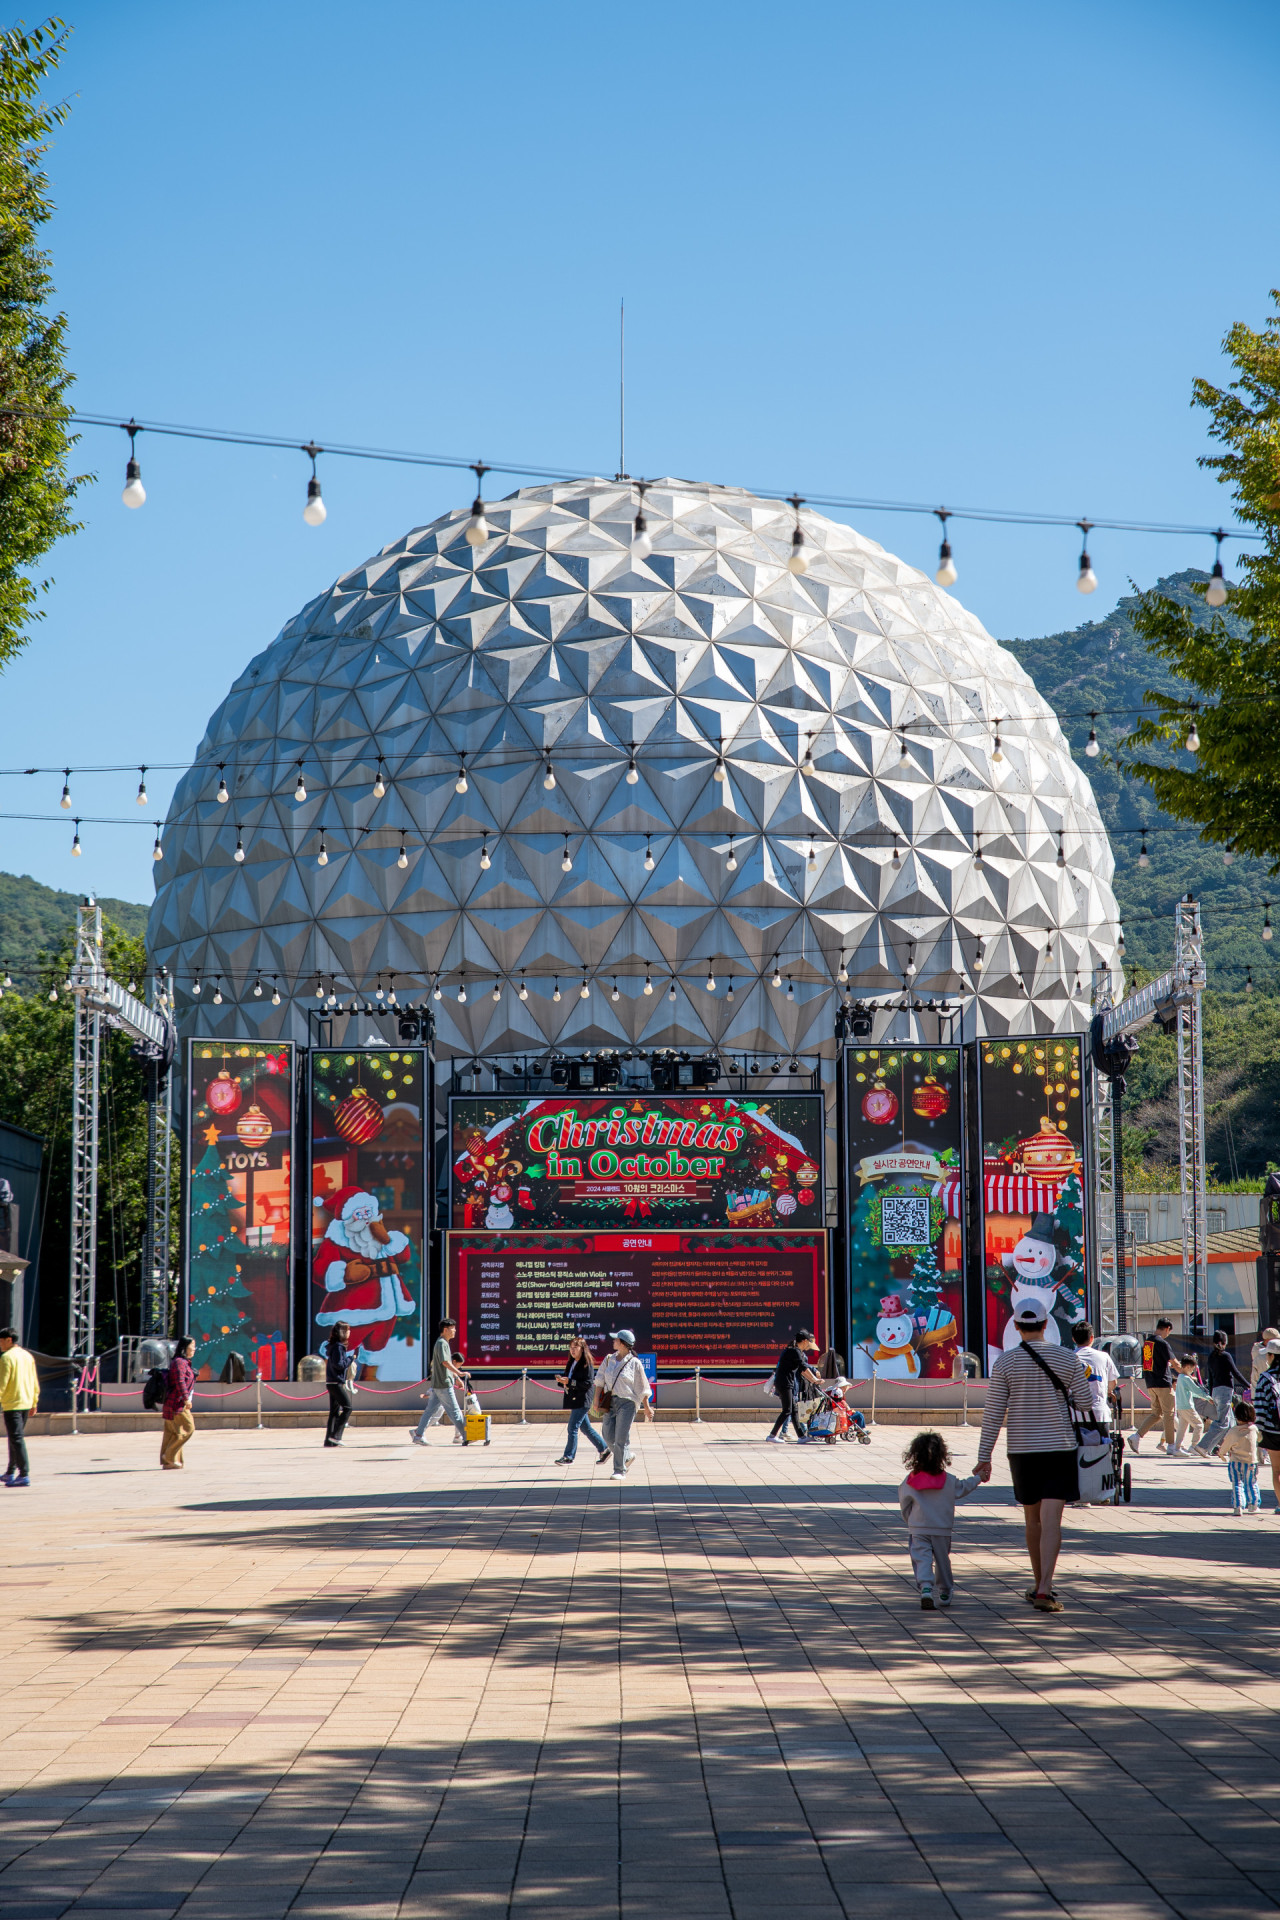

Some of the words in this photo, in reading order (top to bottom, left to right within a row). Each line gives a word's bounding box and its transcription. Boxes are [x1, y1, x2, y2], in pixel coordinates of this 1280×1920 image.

[527, 1106, 745, 1154] Christmas
[226, 1151, 268, 1170] TOYS
[547, 1151, 582, 1179] in
[589, 1149, 725, 1179] October
[873, 1158, 897, 1169] 실시간
[587, 1185, 601, 1193] 2024
[602, 1185, 621, 1193] 서울랜드
[624, 1183, 648, 1193] 10월의
[650, 1183, 686, 1193] 크리스마스
[622, 1238, 637, 1248] 공연
